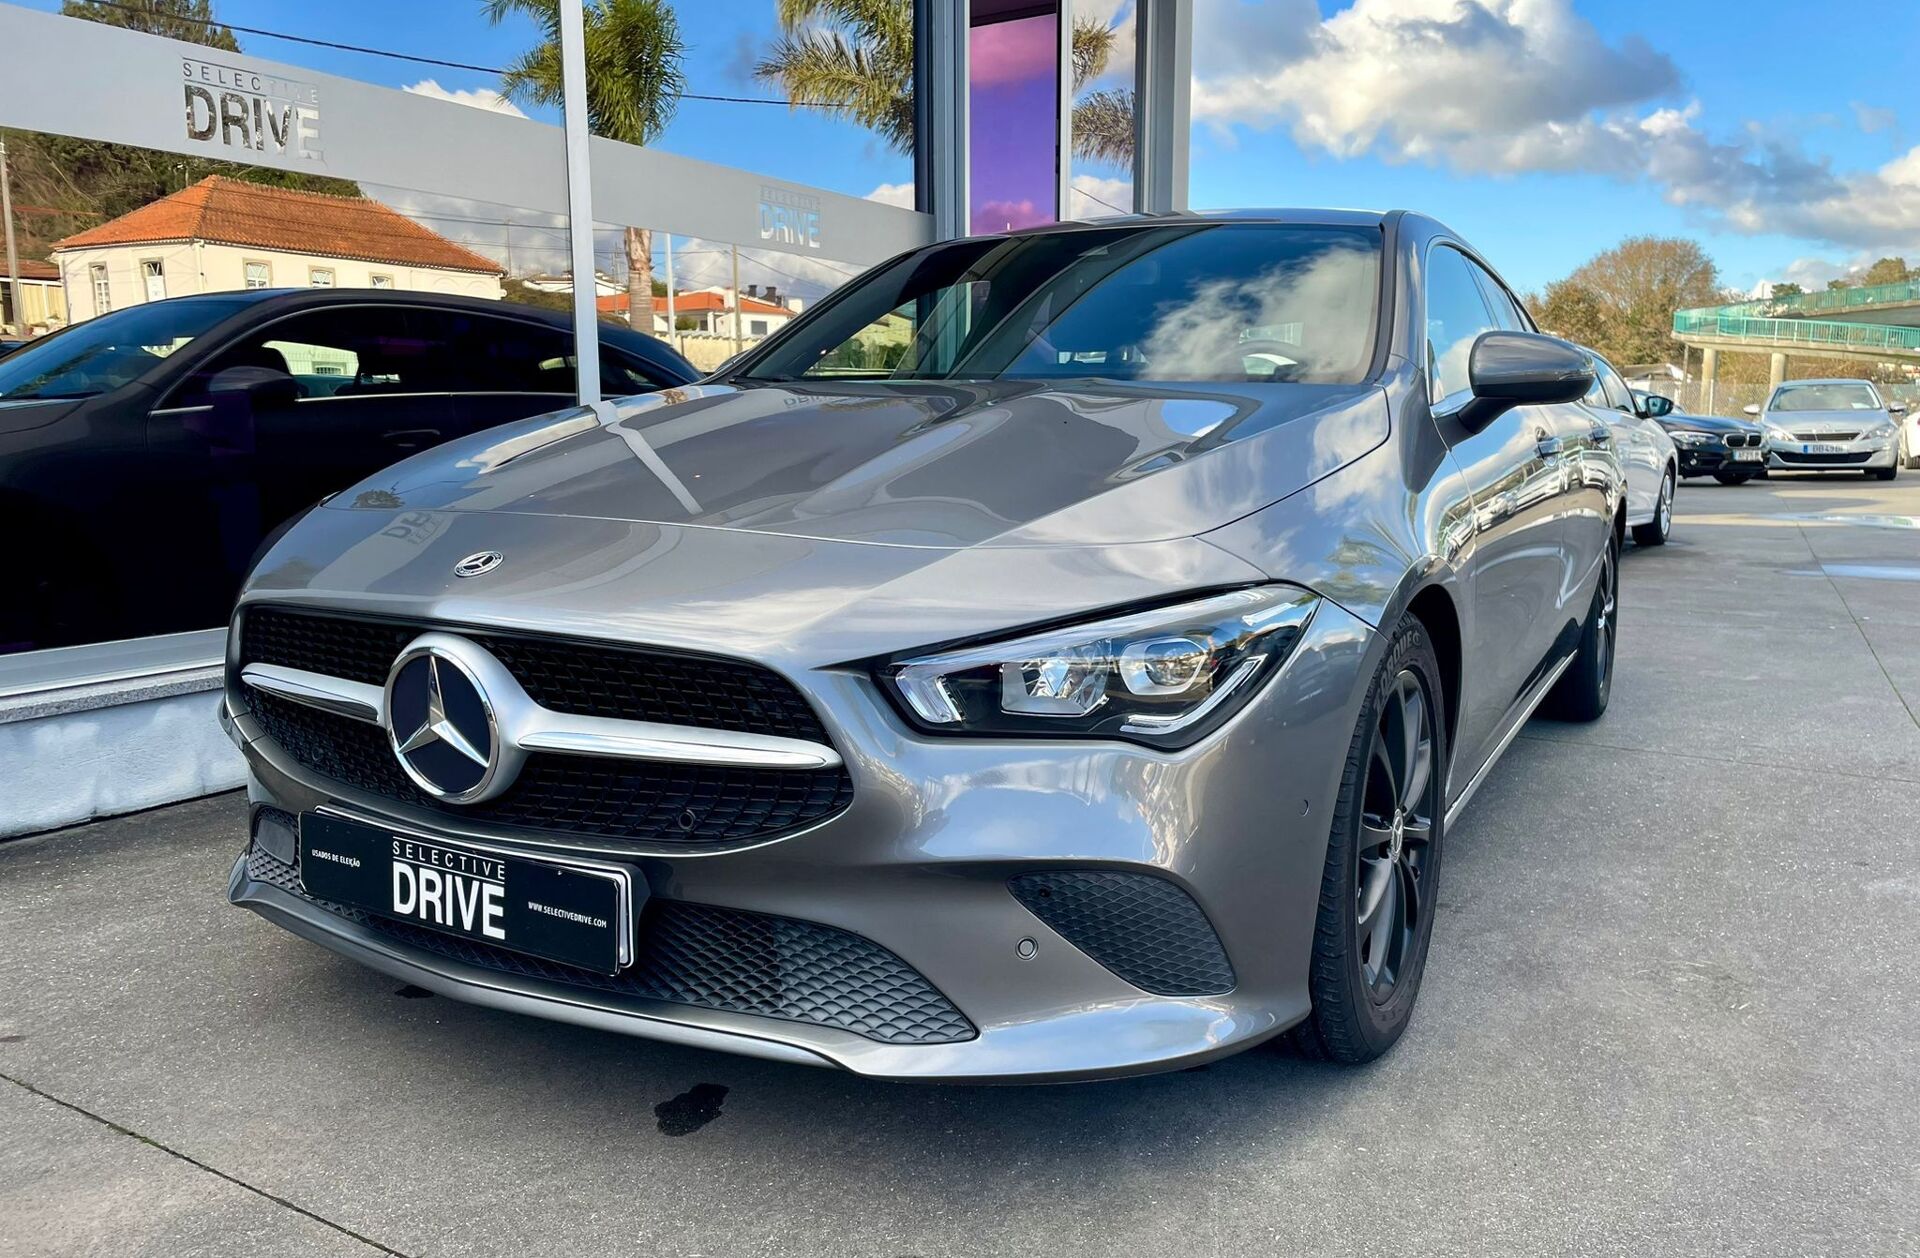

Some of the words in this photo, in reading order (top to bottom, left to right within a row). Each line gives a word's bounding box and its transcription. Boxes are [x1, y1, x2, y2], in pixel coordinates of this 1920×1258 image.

[184, 84, 320, 160] DRIVE
[760, 204, 821, 248] DRIVE
[311, 849, 331, 860] USADOS
[332, 854, 339, 862] DE
[392, 840, 505, 880] SELECTIVE
[392, 861, 506, 940] DRIVE
[527, 901, 607, 928] WWW.SELECTIVEDRIVE.COM
